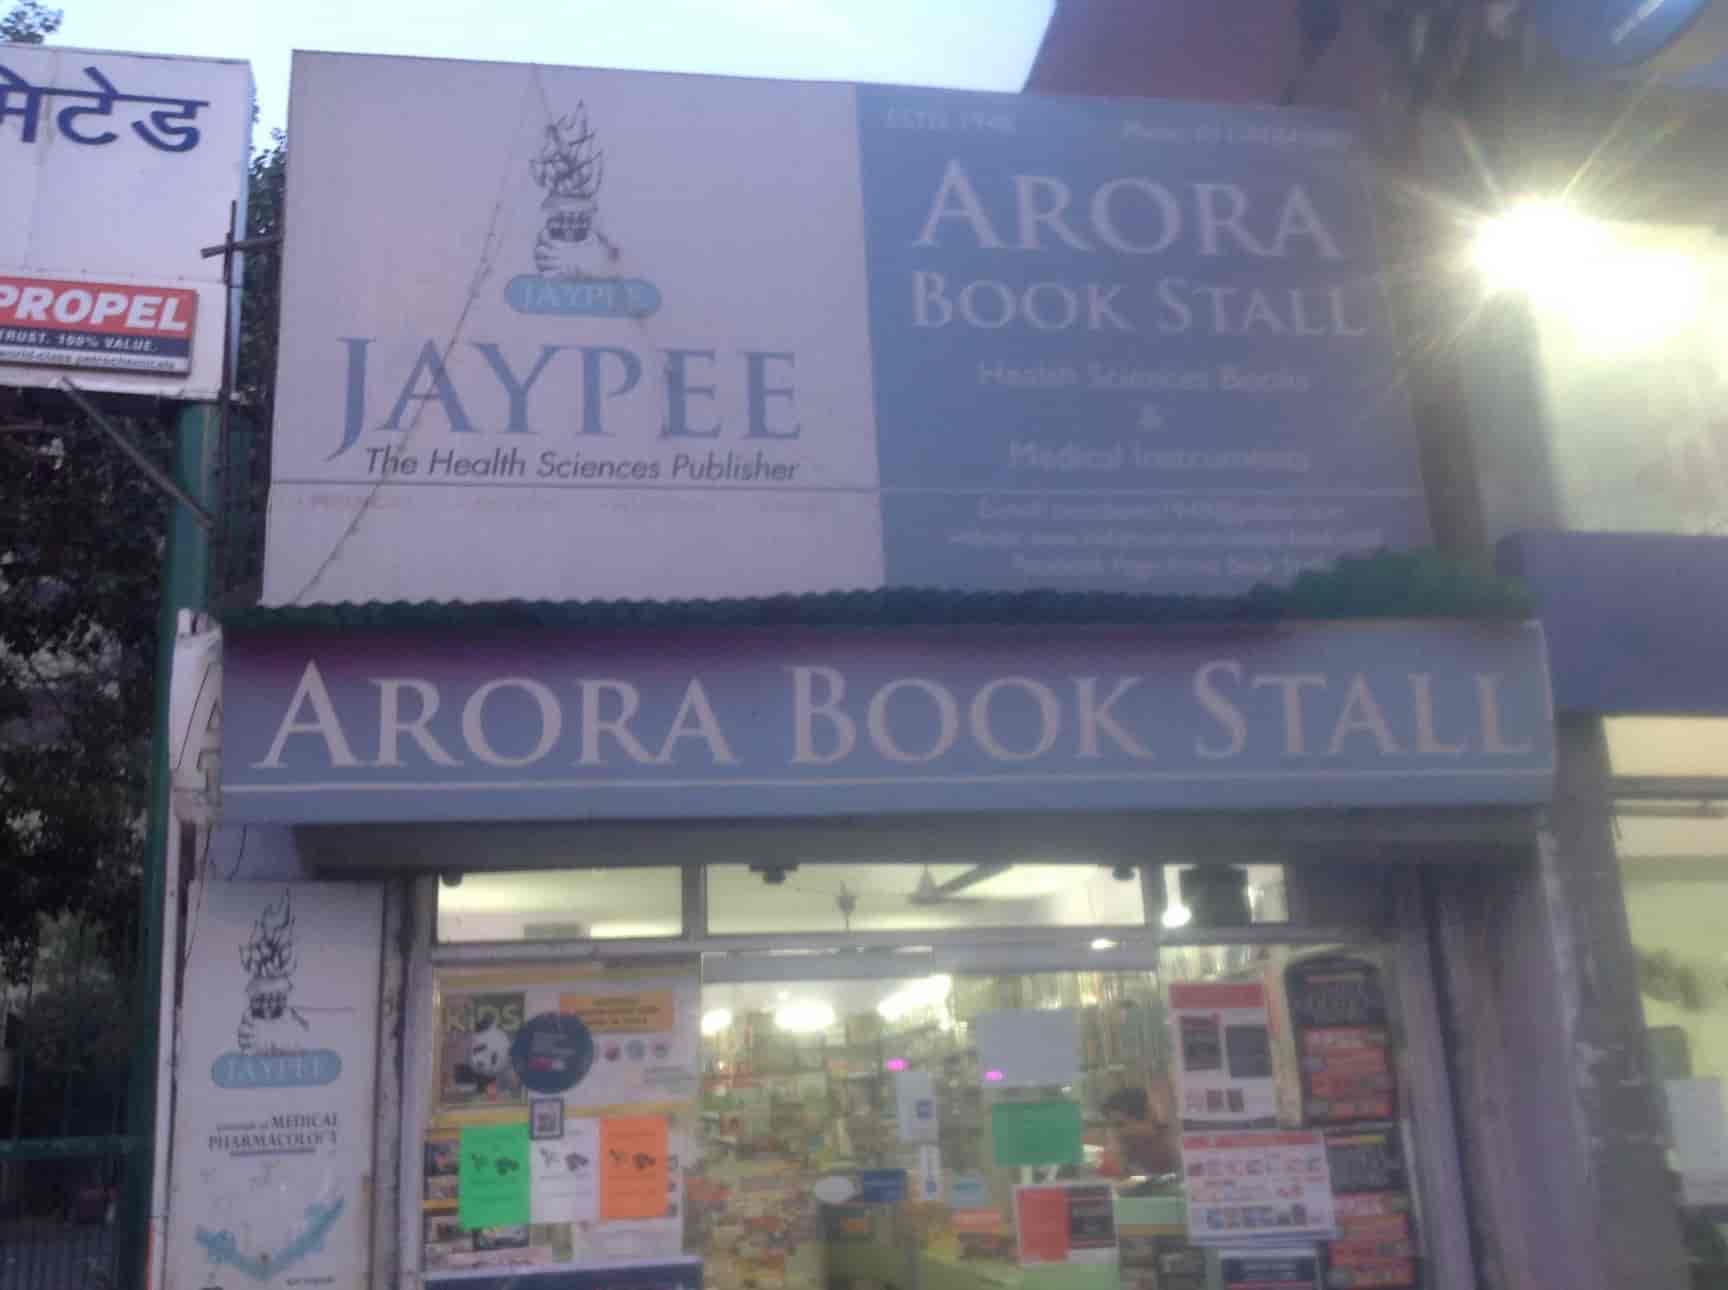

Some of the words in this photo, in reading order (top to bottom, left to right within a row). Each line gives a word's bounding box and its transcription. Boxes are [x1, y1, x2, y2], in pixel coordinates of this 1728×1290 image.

[912, 160, 1343, 260] ARORA
[911, 269, 1136, 331] BOOK
[1155, 277, 1369, 337] STALL
[327, 337, 803, 463] JAYPEE
[365, 447, 418, 476] The
[430, 448, 525, 478] Health
[536, 450, 660, 480] Sciences
[672, 451, 801, 481] Publisher
[251, 660, 743, 769] ARORA
[784, 664, 1153, 766] BOOK
[1193, 659, 1533, 761] STALL
